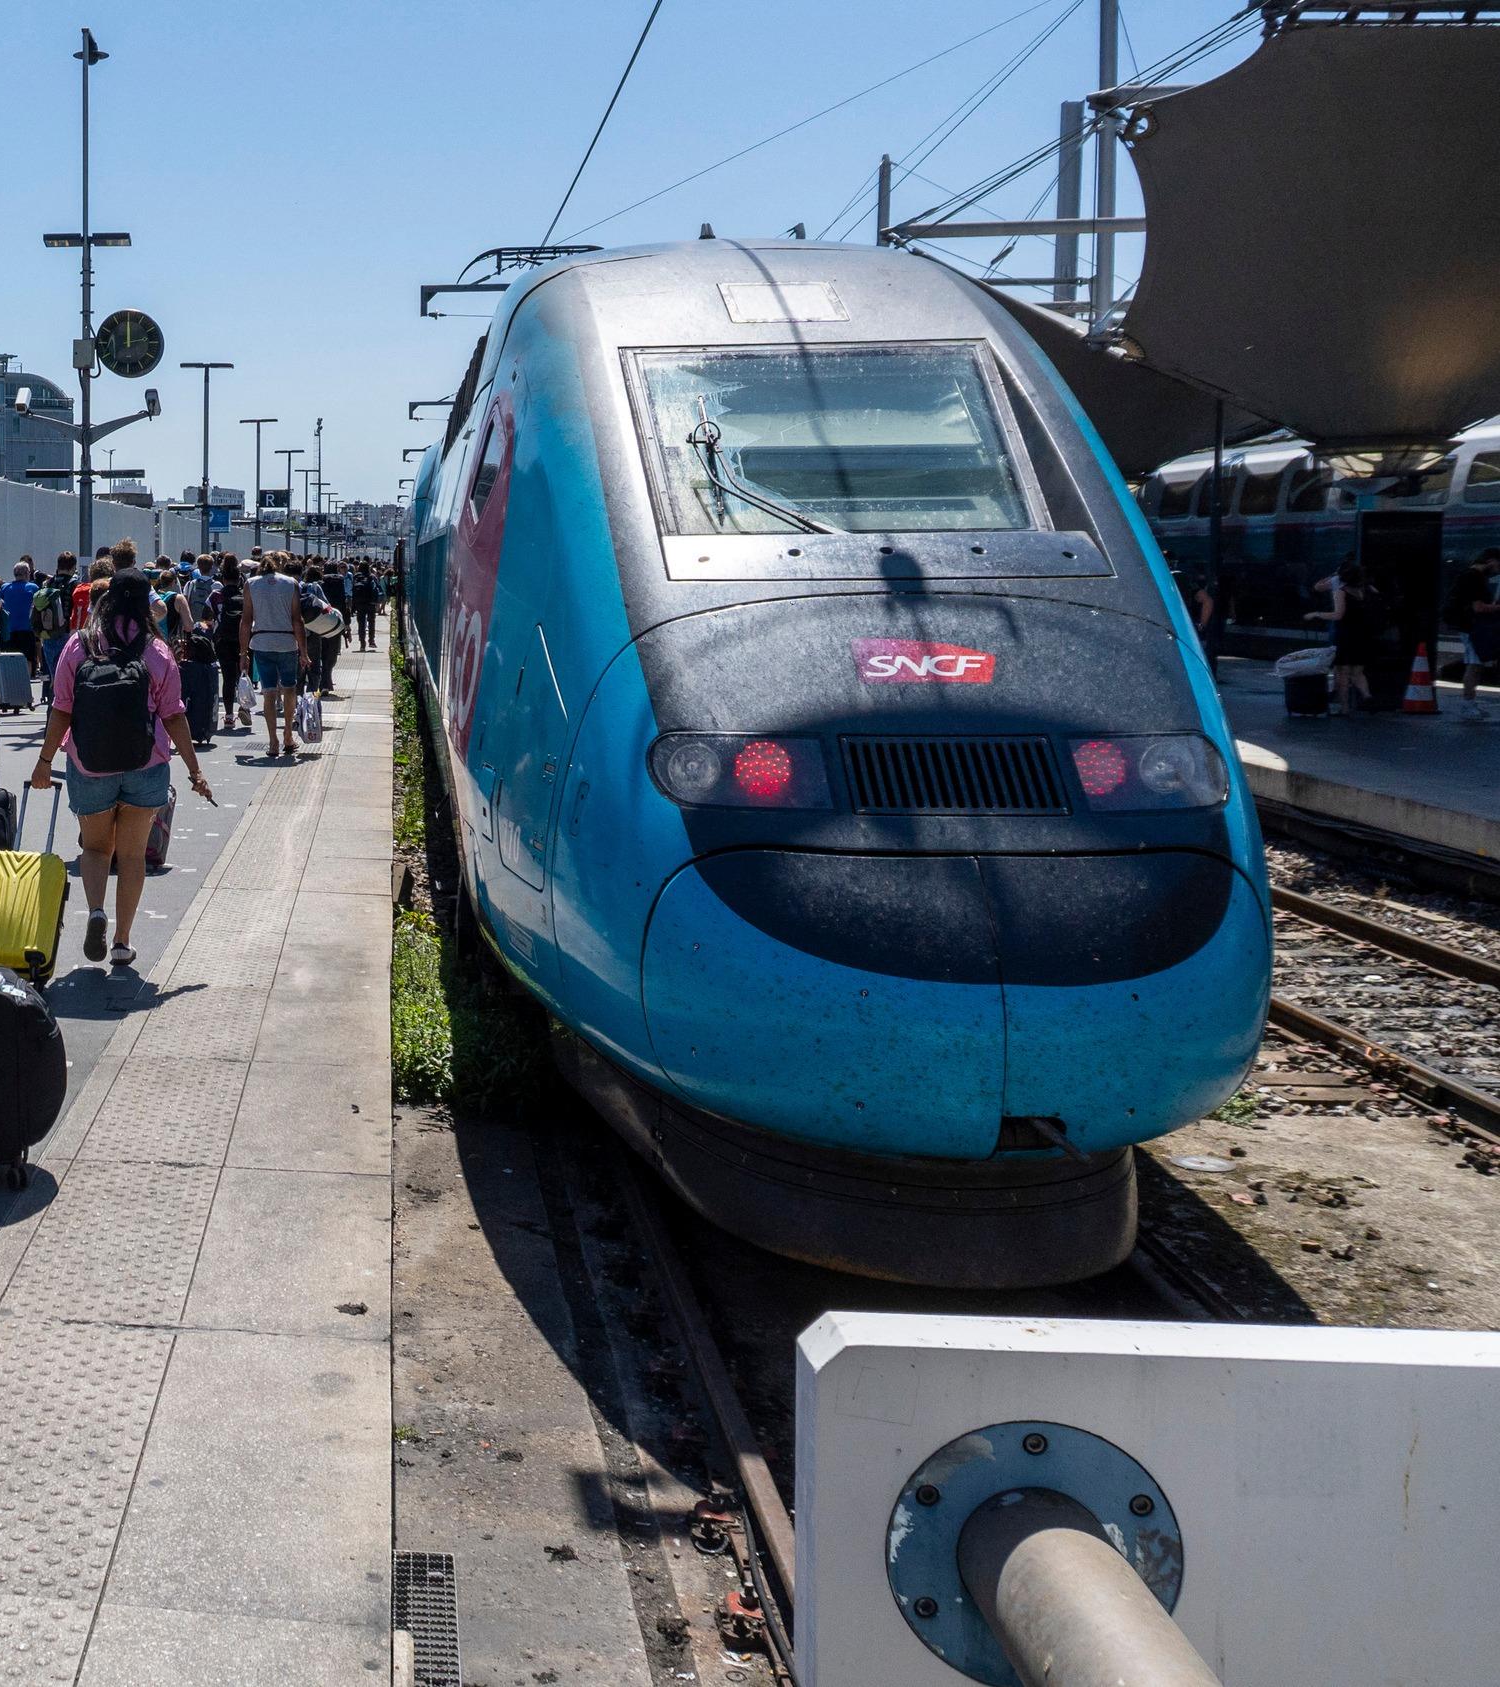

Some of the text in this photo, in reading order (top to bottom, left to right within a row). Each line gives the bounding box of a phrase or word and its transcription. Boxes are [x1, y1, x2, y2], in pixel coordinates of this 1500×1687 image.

[266, 494, 275, 507] R
[311, 517, 318, 526] S
[865, 655, 986, 678] SNCF
